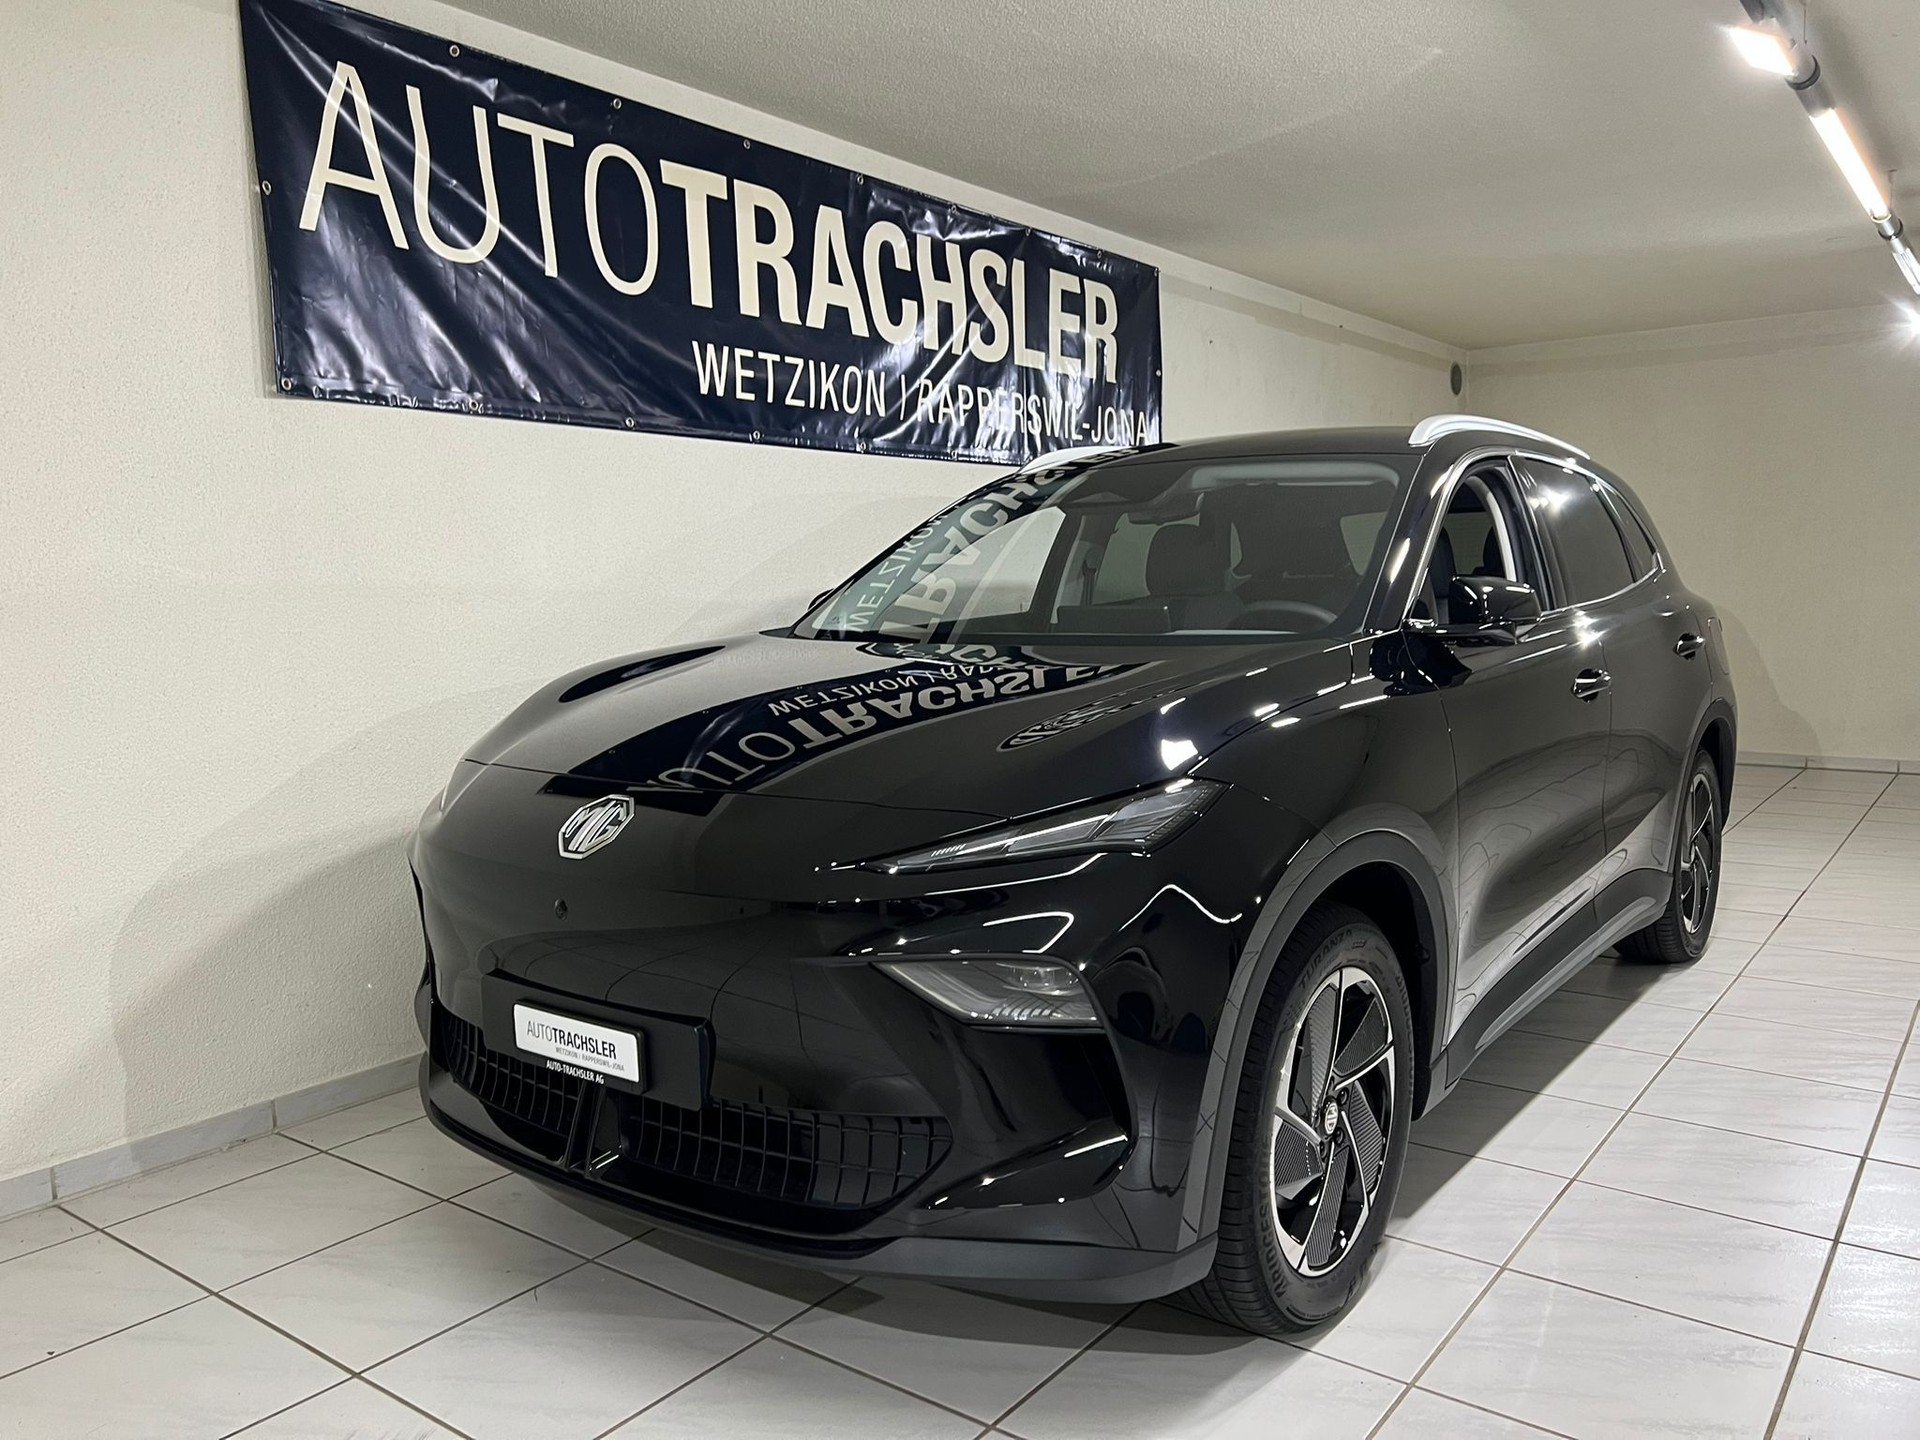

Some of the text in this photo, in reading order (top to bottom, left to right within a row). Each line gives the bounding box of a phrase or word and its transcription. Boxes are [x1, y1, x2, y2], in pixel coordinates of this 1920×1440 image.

[299, 61, 1118, 385] AUTOTRACHSLER
[691, 340, 886, 419] WETZIKON
[916, 377, 1150, 445] RAPPERSWIL-JONA
[563, 799, 629, 853] MG
[527, 1020, 617, 1060] AUTOTRACHSLER
[546, 1059, 605, 1085] AUTO-TRACHSLER AG
